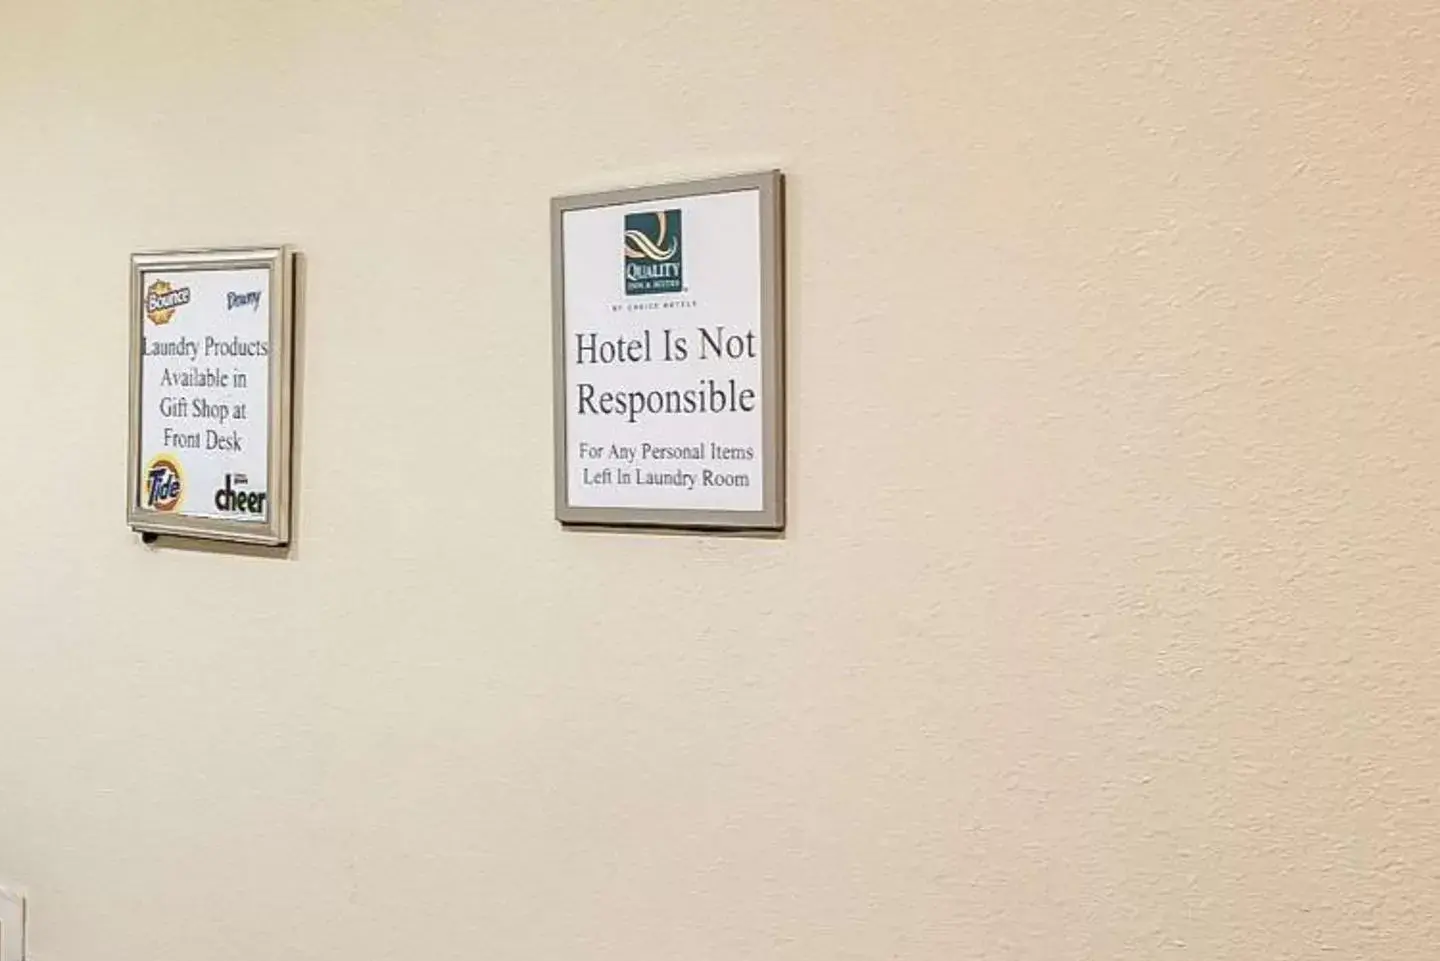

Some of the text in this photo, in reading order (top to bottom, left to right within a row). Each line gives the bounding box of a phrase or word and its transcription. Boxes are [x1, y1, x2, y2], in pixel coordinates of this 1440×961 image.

[627, 262, 679, 280] QUALITY
[148, 288, 189, 311] Bounce
[143, 335, 268, 360] Laundry Products
[576, 326, 756, 363] Hotel Is Not
[161, 368, 247, 388] Available in
[160, 397, 247, 423] Gift Shop at
[577, 379, 755, 422] Responsible
[164, 428, 242, 451] Front Desk
[579, 443, 753, 463] For Any Personal Items
[148, 468, 180, 506] Tide
[583, 468, 750, 490] Left In Laundry Room
[215, 474, 266, 512] cheer
